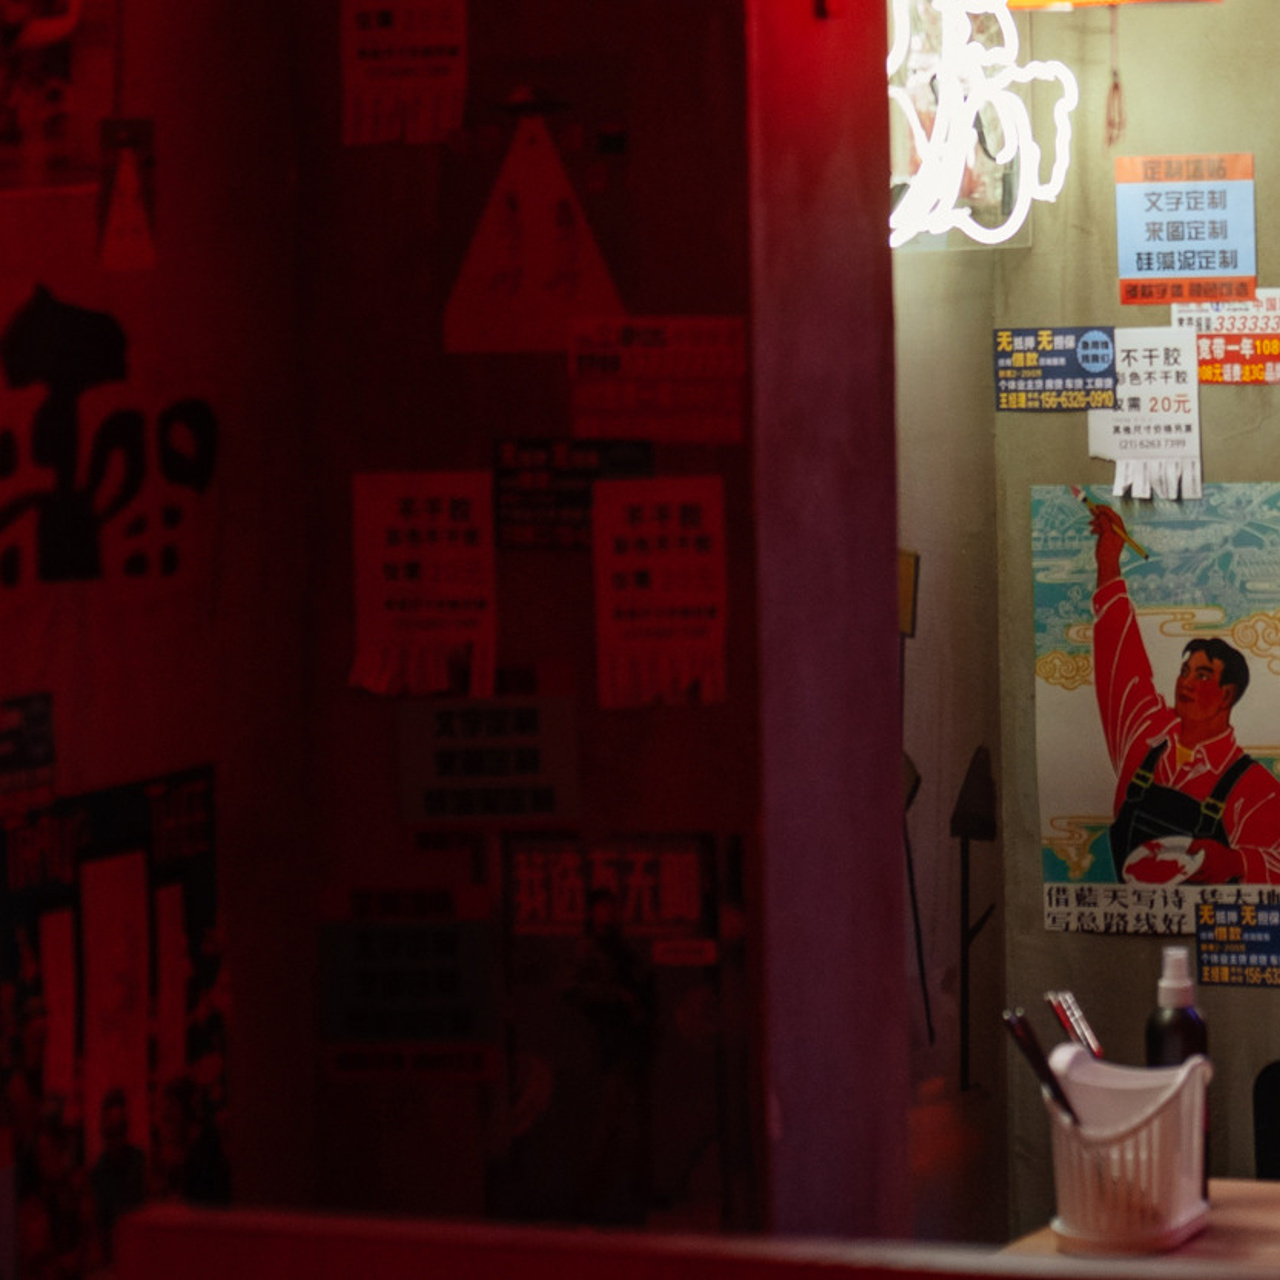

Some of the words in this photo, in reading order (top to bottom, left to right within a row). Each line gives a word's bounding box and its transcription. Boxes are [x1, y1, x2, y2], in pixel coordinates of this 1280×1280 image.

[1144, 189, 1228, 212] 文字定制
[1120, 346, 1182, 368] 不干胶
[1149, 393, 1192, 415] 20元
